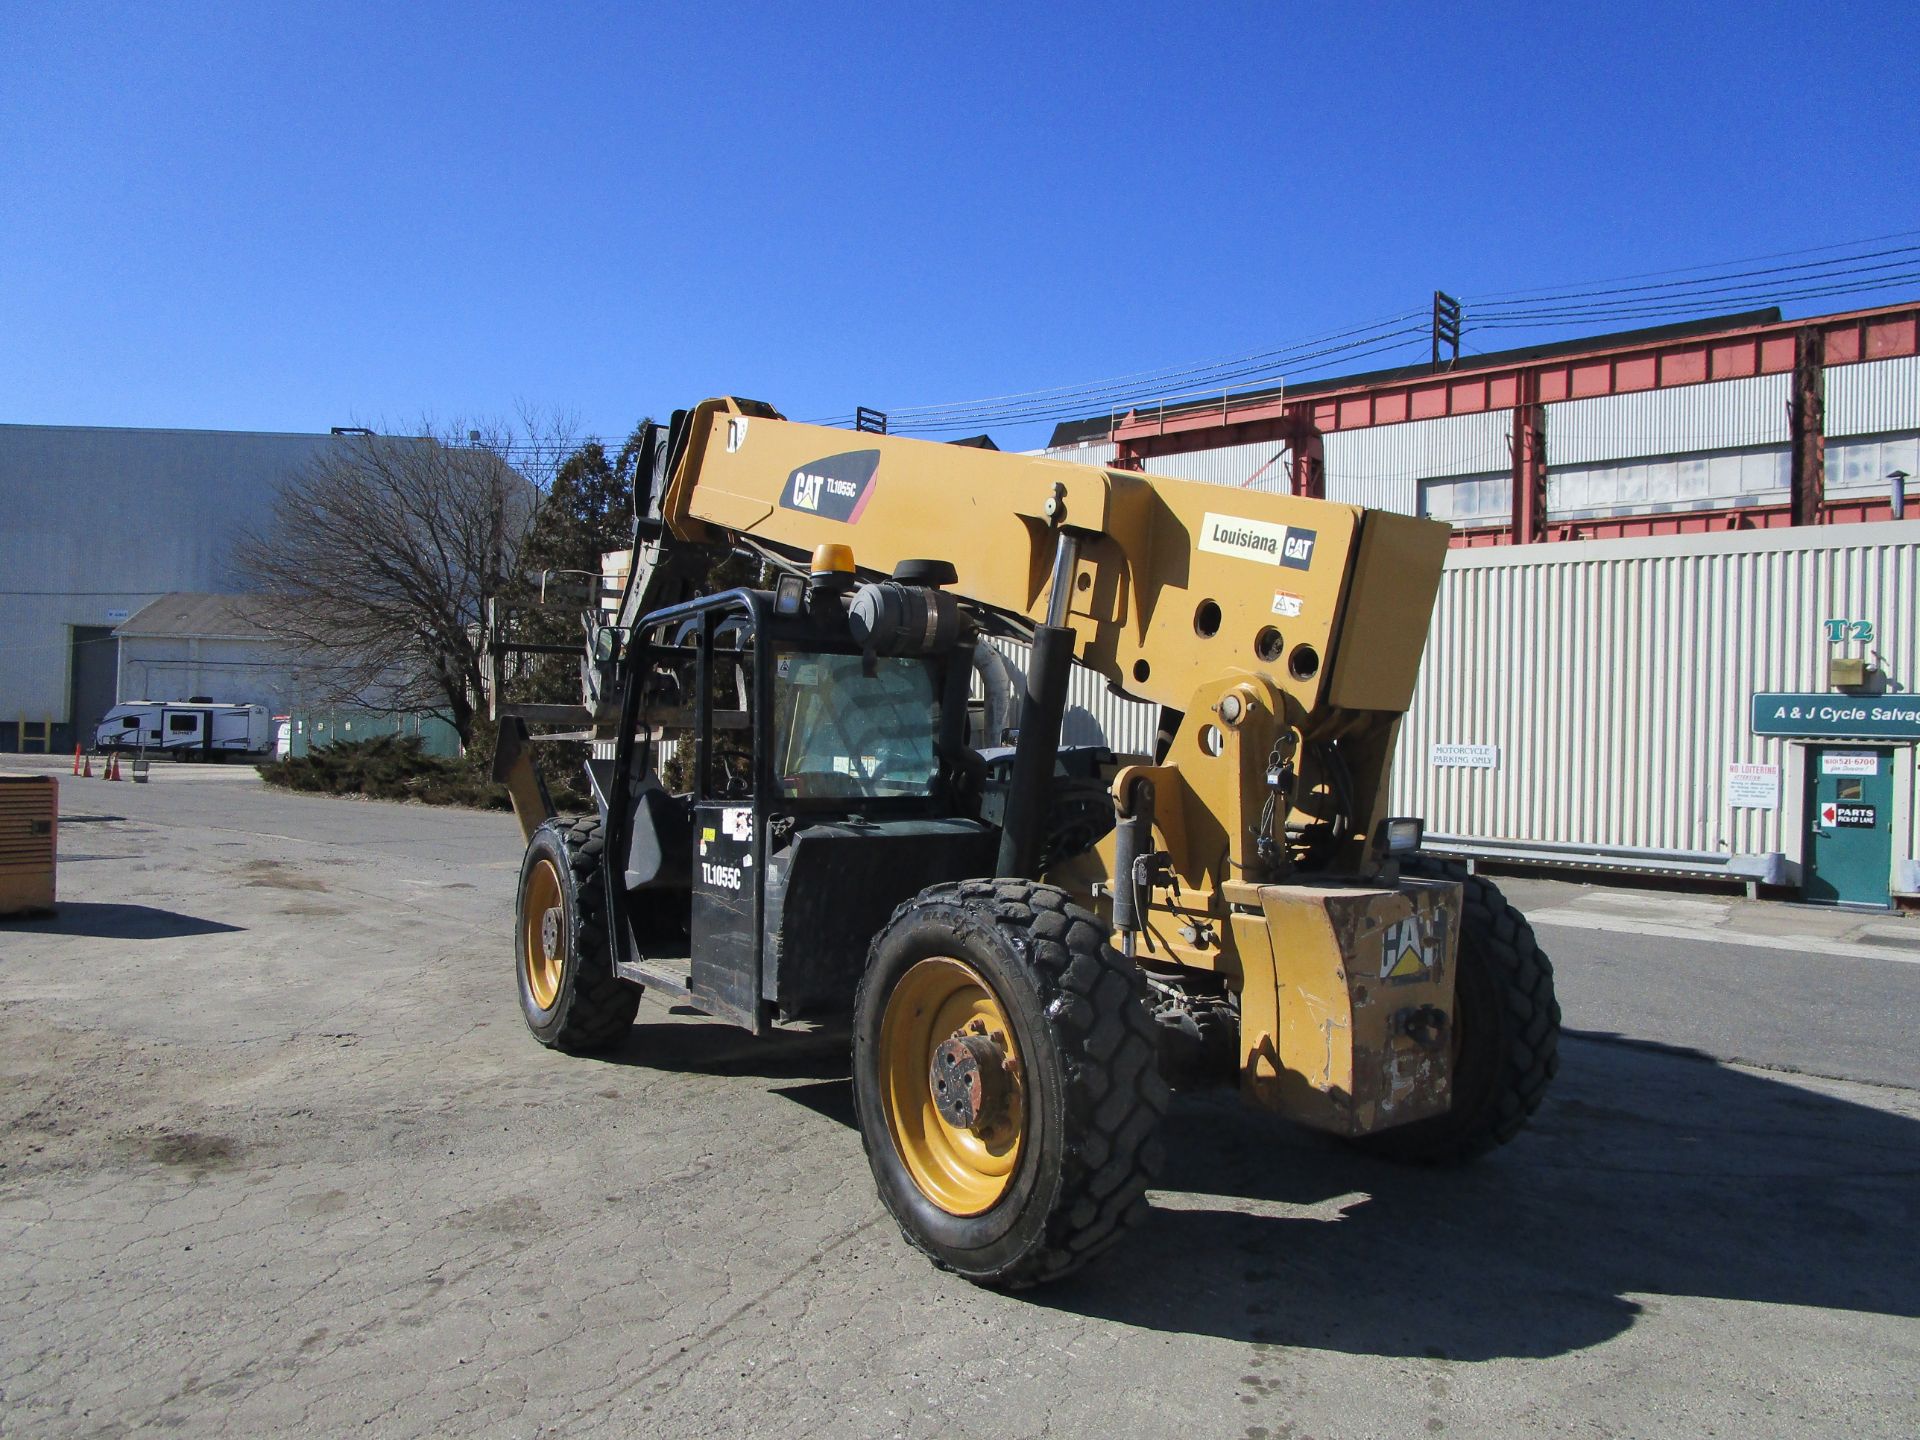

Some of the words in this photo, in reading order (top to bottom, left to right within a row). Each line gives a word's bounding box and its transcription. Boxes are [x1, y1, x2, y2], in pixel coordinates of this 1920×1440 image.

[793, 472, 824, 511] CAT
[826, 478, 857, 498] TL1055C
[1213, 524, 1277, 554] Louisiana
[1284, 537, 1312, 560] CAT
[1774, 707, 1786, 719] A
[1790, 708, 1801, 719] &
[1805, 708, 1816, 720] J
[1819, 707, 1866, 723] Cycle
[1436, 747, 1489, 755] MOTORCYCLE
[1729, 765, 1739, 773] NO
[1741, 765, 1777, 775] LOITERING
[1837, 808, 1874, 817] PARTS
[702, 863, 741, 890] TL1055C
